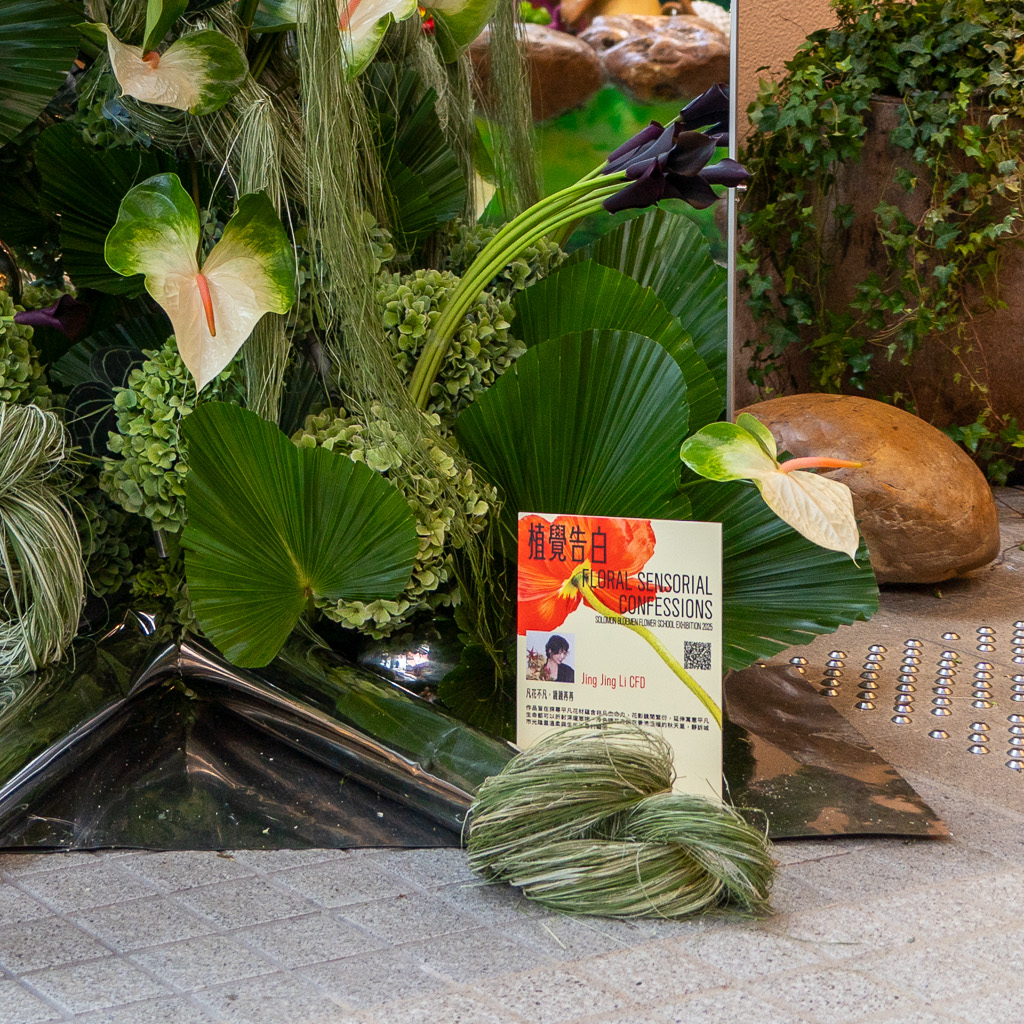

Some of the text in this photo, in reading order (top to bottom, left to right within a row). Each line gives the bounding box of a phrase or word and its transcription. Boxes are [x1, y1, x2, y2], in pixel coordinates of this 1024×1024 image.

[528, 522, 608, 564] 植覺告白
[582, 568, 713, 596] FLORAL SENSORIAL
[619, 594, 713, 620] CONFESSIONS
[594, 616, 713, 631] SOLOMON BLOEMEN FLOWER SCHOOL EXHIBITION 2025
[581, 672, 646, 690] Jing Jing Li CFD
